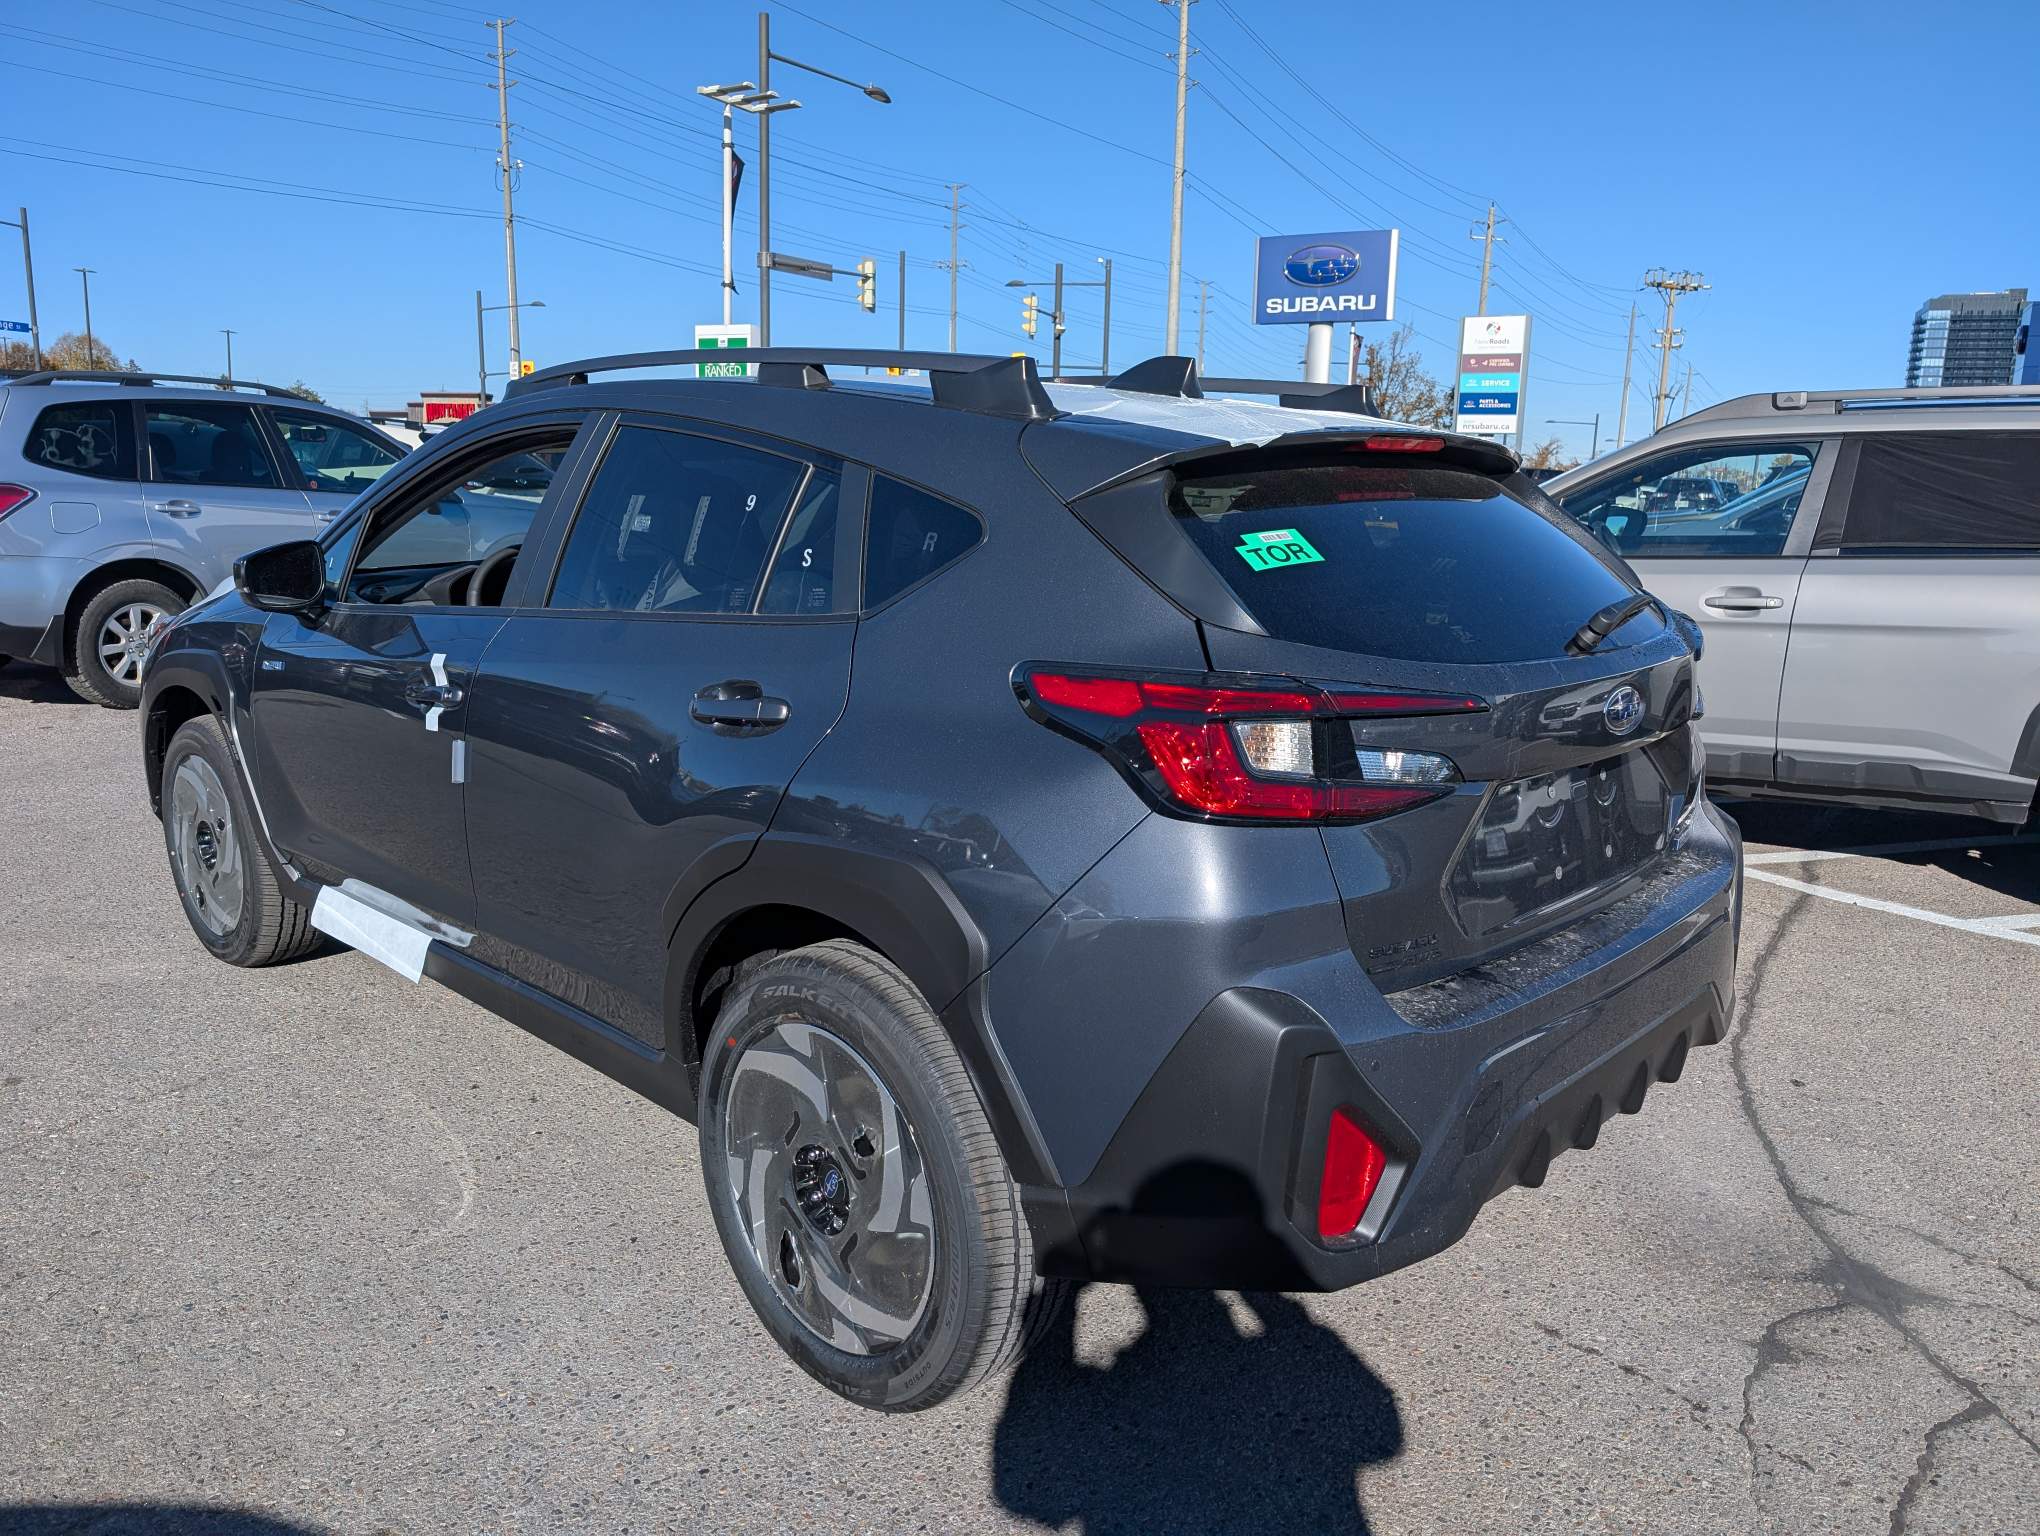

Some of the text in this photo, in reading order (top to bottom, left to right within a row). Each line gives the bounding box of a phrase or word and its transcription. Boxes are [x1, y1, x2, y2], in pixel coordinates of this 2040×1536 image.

[1265, 294, 1377, 314] SUBARU
[704, 364, 742, 378] RANKED
[1463, 422, 1510, 430] nrsubaru.ca
[745, 494, 757, 512] 9
[802, 548, 813, 567] S
[1245, 542, 1313, 566] TOR
